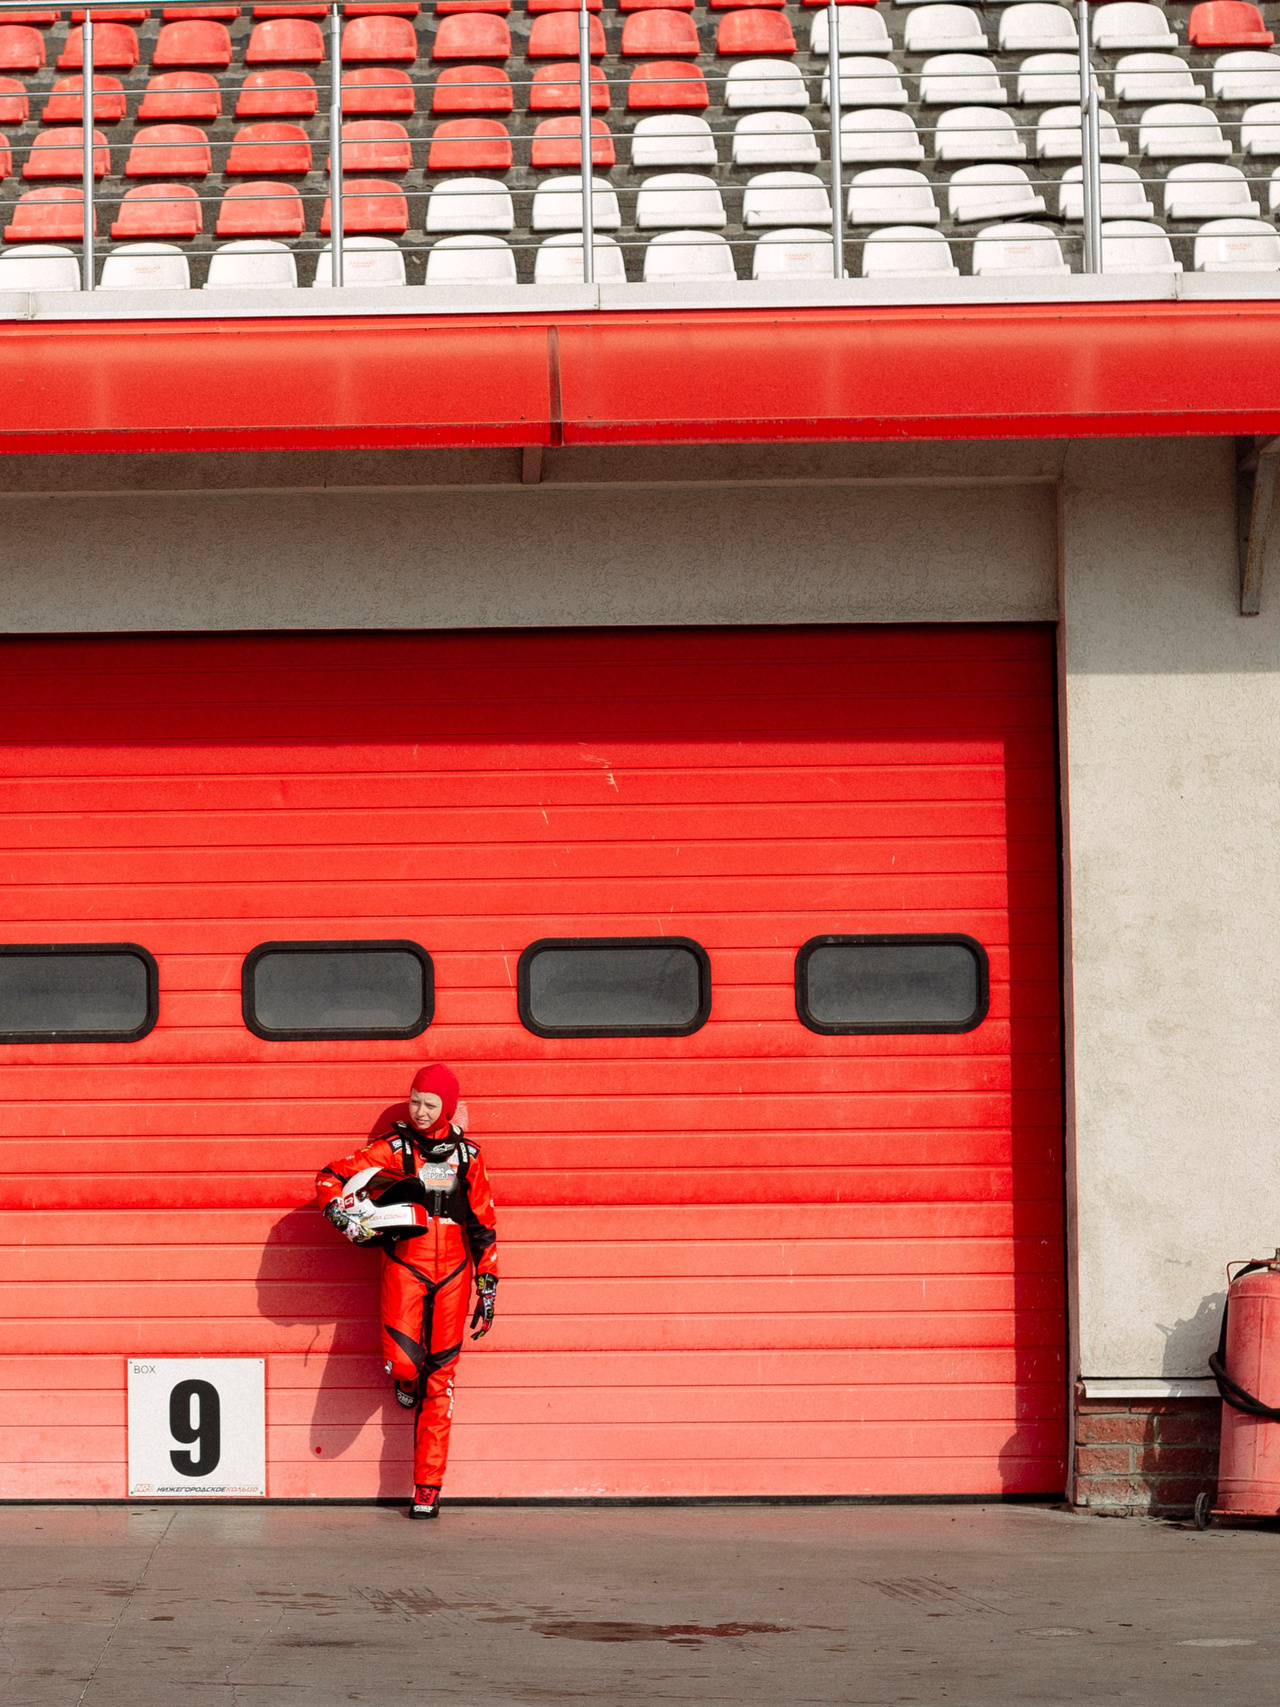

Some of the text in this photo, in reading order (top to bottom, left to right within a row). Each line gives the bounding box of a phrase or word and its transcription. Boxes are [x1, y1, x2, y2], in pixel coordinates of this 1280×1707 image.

[133, 1365, 156, 1374] BOX
[396, 1392, 414, 1405] OMP
[169, 1379, 220, 1477] 9
